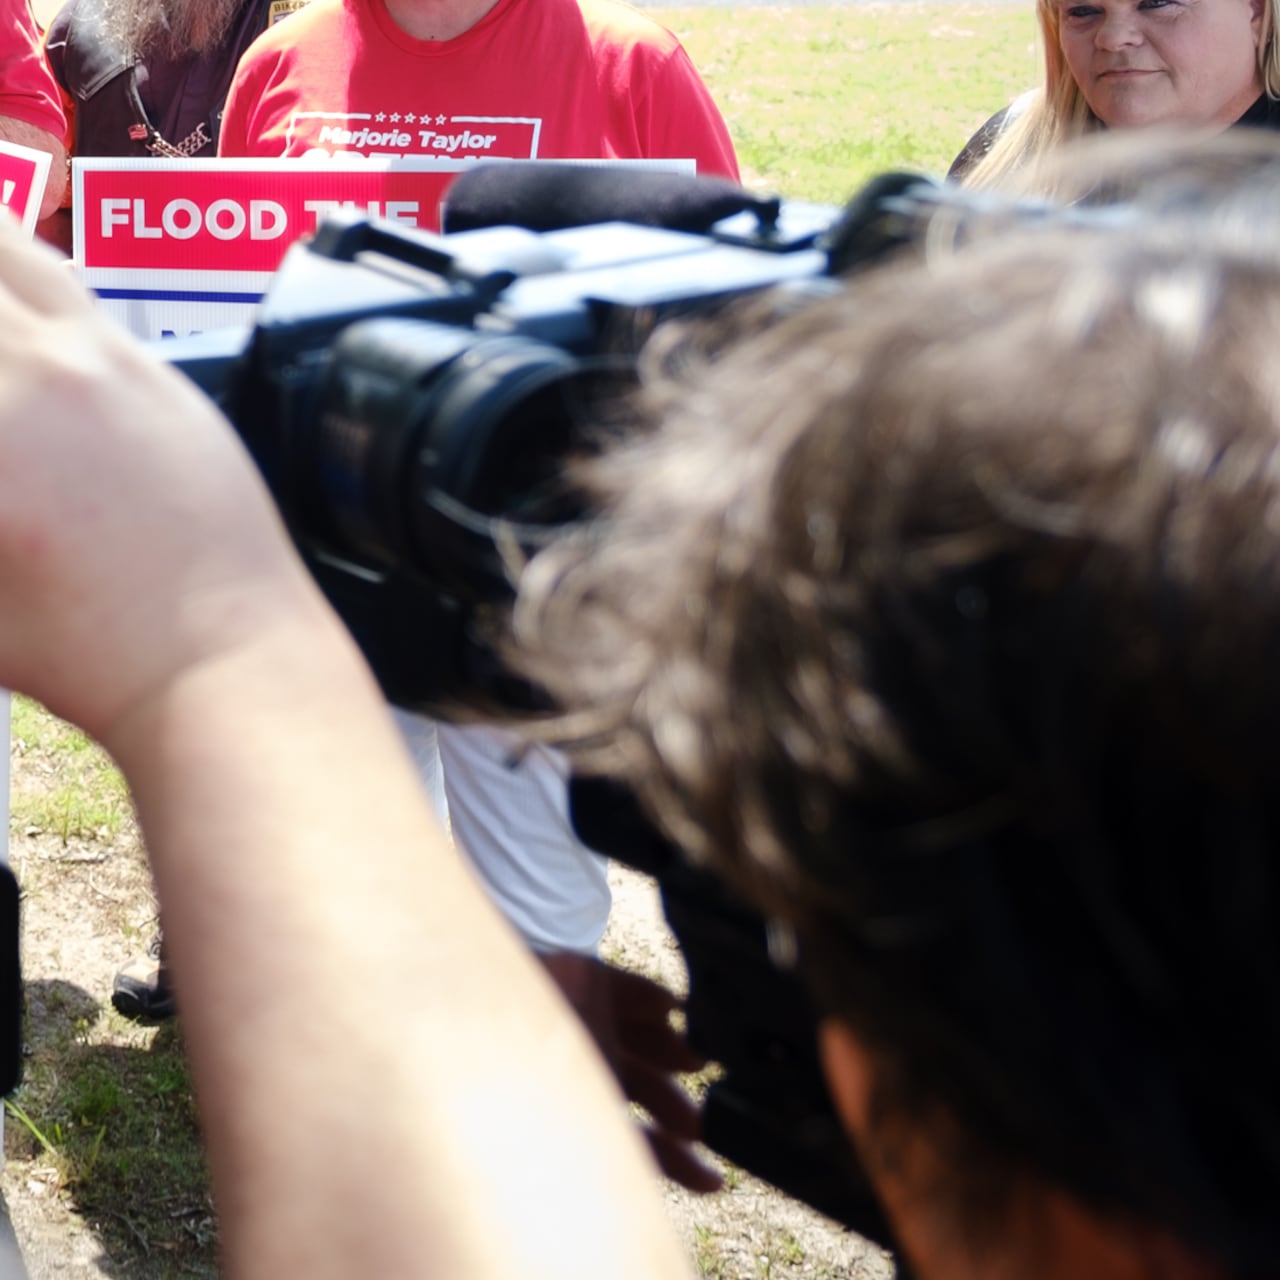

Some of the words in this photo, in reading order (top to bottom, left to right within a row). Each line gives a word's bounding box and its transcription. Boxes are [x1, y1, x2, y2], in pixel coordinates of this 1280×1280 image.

[319, 125, 412, 148] Marjorie
[419, 130, 497, 152] Taylor
[101, 198, 288, 240] FLOOD
